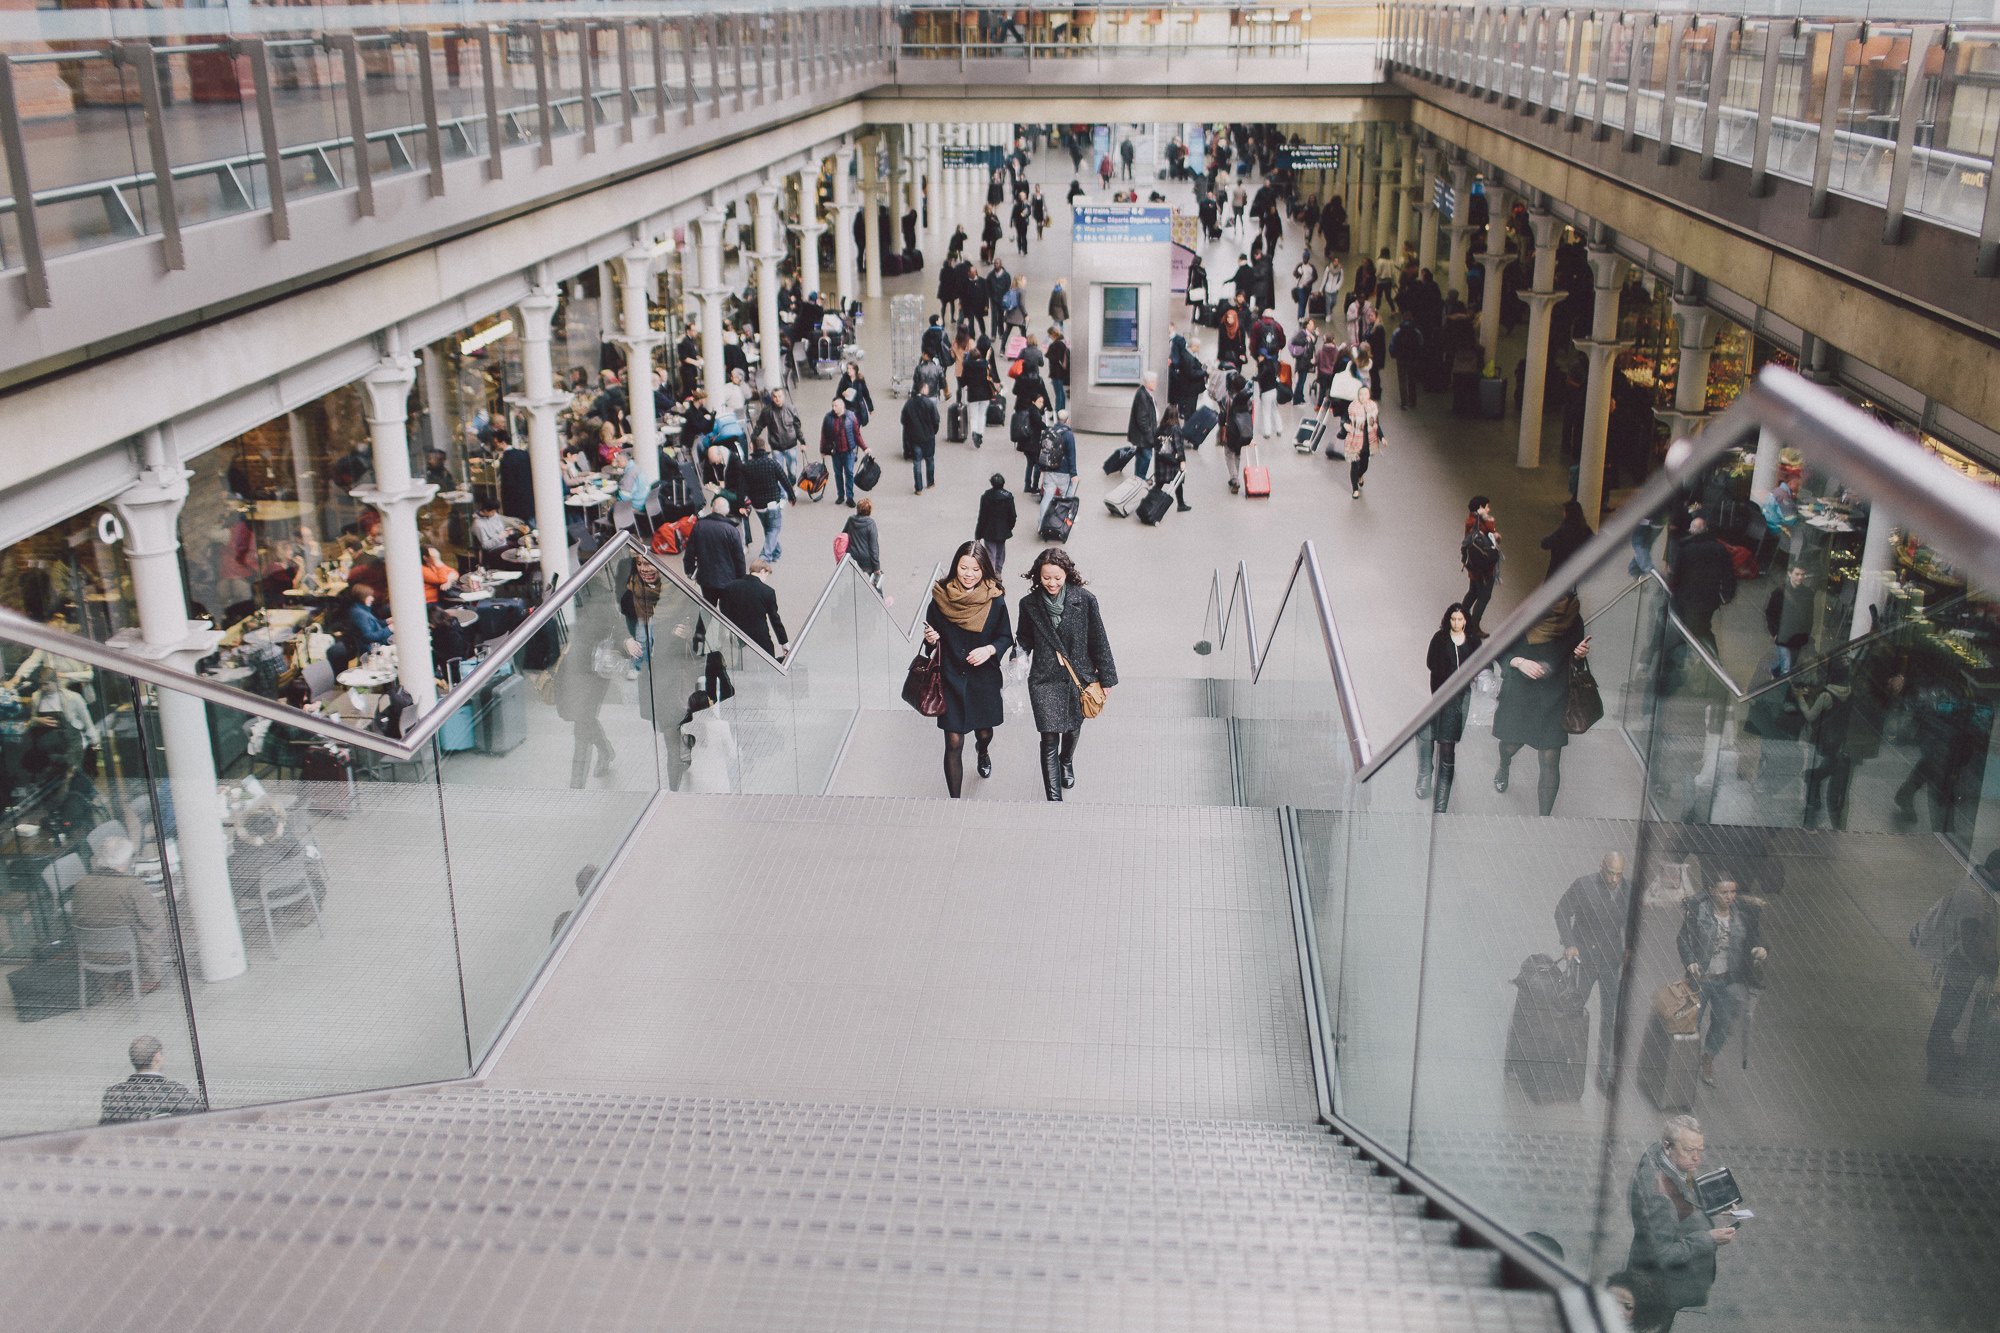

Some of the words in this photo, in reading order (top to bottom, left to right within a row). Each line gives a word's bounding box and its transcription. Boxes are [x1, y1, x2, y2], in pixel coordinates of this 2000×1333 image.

[1084, 207, 1092, 215] All
[1092, 207, 1110, 215] trains
[1107, 216, 1129, 224] Départs
[1130, 216, 1161, 225] Departures
